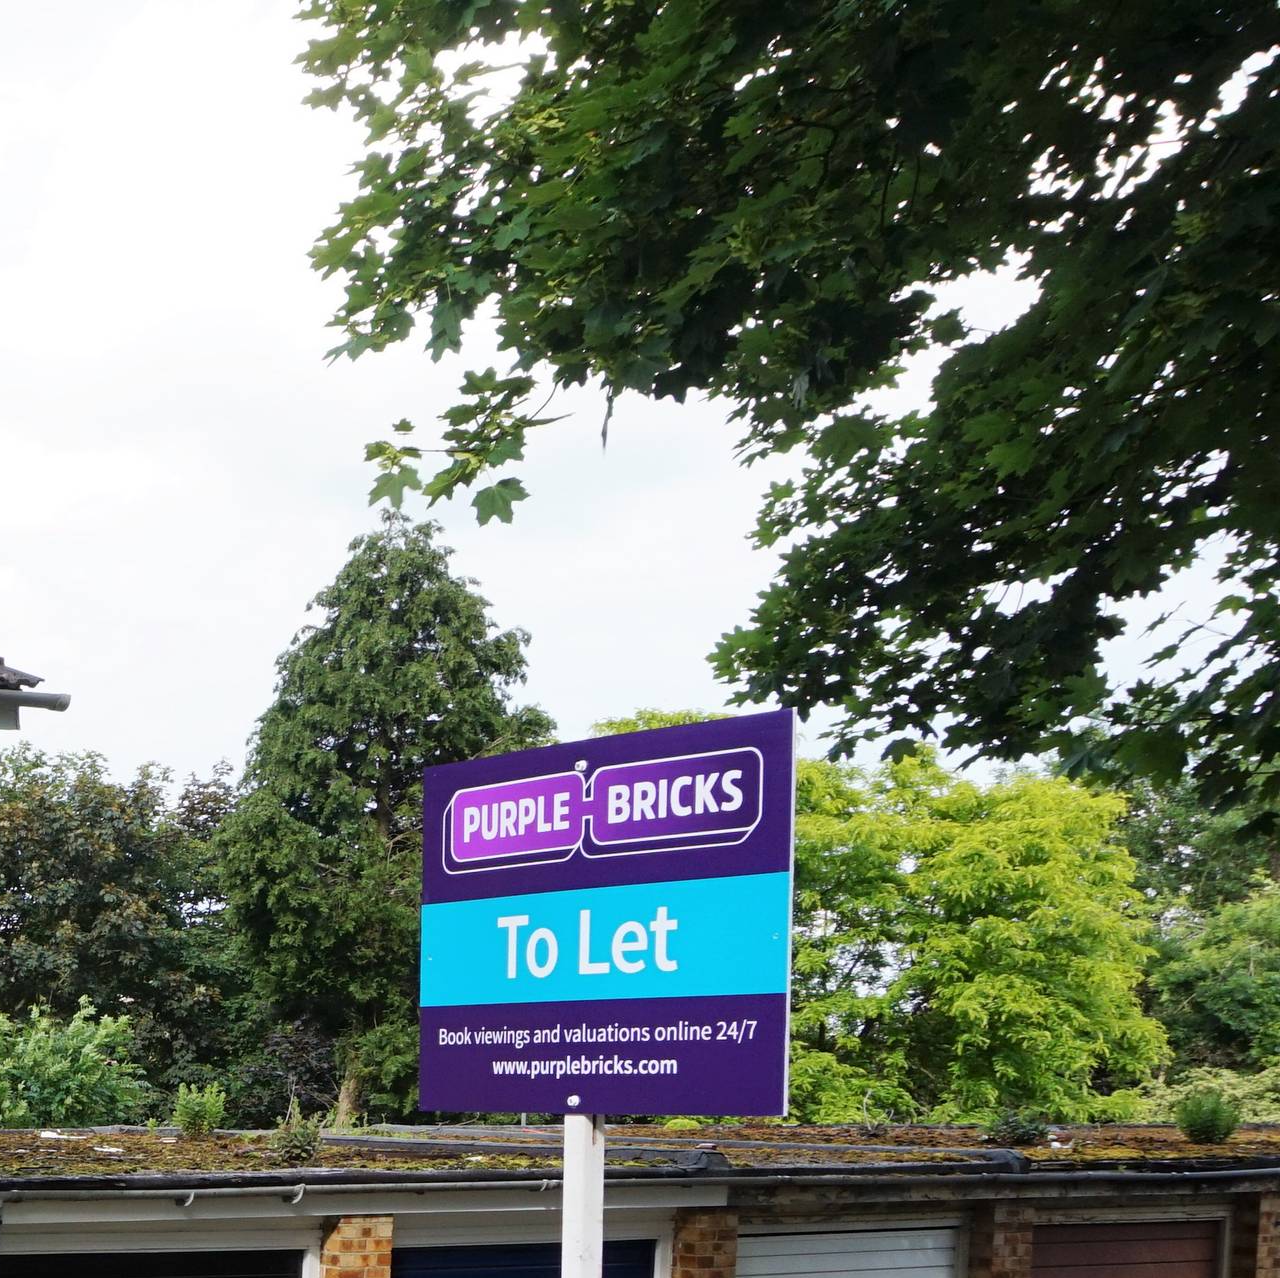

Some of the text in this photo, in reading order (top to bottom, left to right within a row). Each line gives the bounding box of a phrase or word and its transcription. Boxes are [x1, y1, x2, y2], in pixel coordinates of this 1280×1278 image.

[463, 769, 743, 843] PURPLE BRICKS
[497, 906, 678, 979] To Let
[439, 1020, 757, 1049] Book viewings and valuations online 24/7
[493, 1055, 678, 1079] www.purplebricks.com
